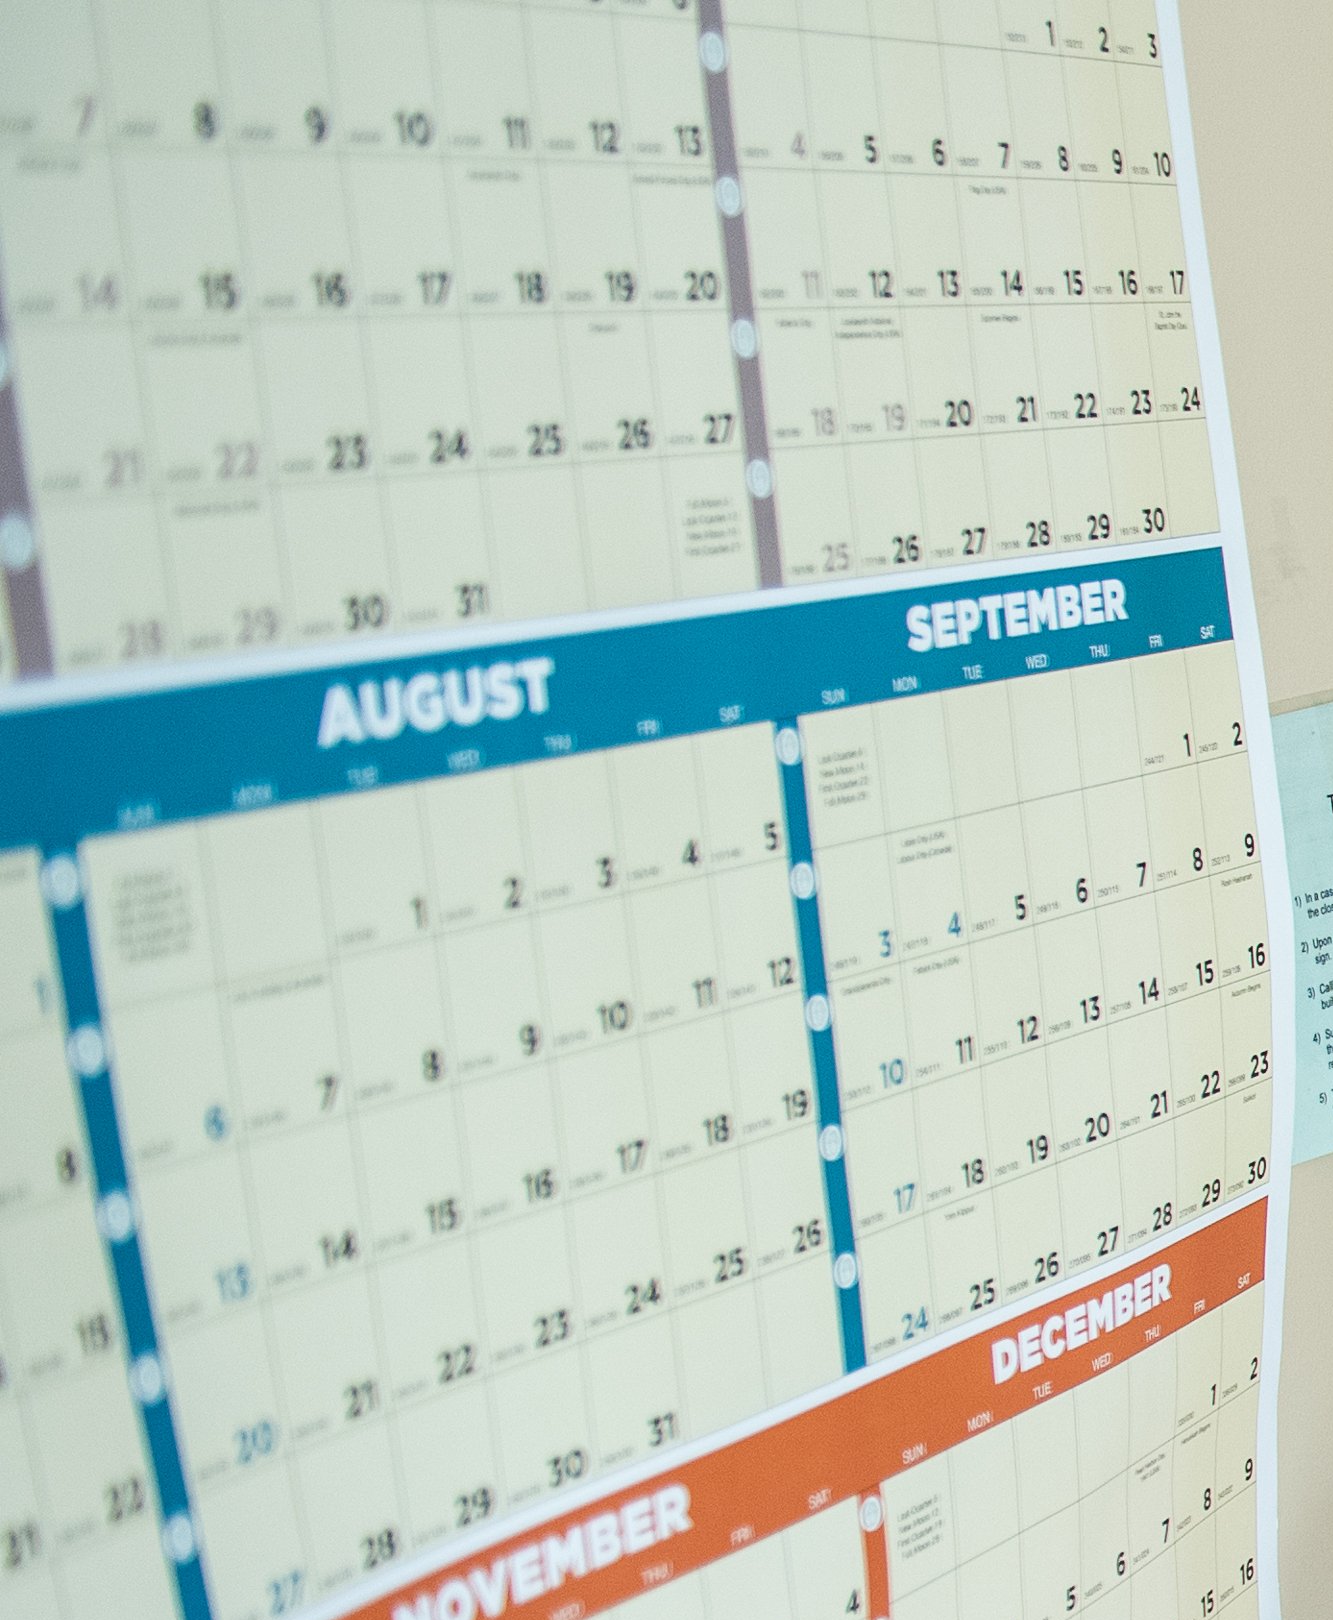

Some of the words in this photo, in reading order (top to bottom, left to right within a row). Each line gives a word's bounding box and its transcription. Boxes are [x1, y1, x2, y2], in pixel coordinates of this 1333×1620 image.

[503, 117, 530, 148] 11
[590, 122, 619, 154] 12
[869, 270, 893, 298] 12
[938, 270, 959, 297] 13
[1001, 270, 1023, 295] 14
[1064, 270, 1083, 295] 15
[1119, 270, 1138, 295] 16
[1170, 270, 1184, 294] 17
[907, 580, 1127, 652] SEPTEMBER
[893, 676, 917, 692] MON
[962, 665, 982, 681] TUE
[1025, 655, 1048, 669] WED
[1089, 645, 1108, 659] THU
[1149, 635, 1162, 648] FRI
[1200, 625, 1215, 640] SAT
[318, 656, 554, 749] AUGUST
[1015, 894, 1026, 920] 5
[1077, 878, 1088, 903] 6
[1136, 862, 1146, 887] 7
[1193, 847, 1203, 871] 8
[1245, 833, 1254, 857] 9
[1294, 895, 1302, 908] 1)
[1304, 893, 1313, 903] In
[1313, 892, 1319, 901] a
[1307, 908, 1319, 919] the
[1300, 941, 1309, 953] 2)
[1312, 936, 1332, 950] Upon
[1314, 952, 1330, 965] sign.
[1307, 986, 1315, 999] 3)
[1312, 1032, 1321, 1044] 4)
[1319, 1092, 1327, 1104] 5)
[525, 1169, 554, 1198] 16
[617, 1139, 646, 1172] 17
[704, 1114, 730, 1144] 18
[903, 1307, 929, 1340] 24
[971, 1278, 995, 1310] 25
[1035, 1252, 1059, 1283] 26
[1098, 1226, 1119, 1256] 27
[1153, 1202, 1172, 1231] 28
[1202, 1179, 1220, 1207] 29
[1248, 1157, 1266, 1184] 30
[992, 1263, 1171, 1385] DECEMBER
[1033, 1381, 1052, 1400] TUE
[1091, 1352, 1112, 1373] WED
[1145, 1325, 1160, 1344] THU
[1193, 1300, 1205, 1313] FRI
[1237, 1274, 1251, 1289] SAT
[1201, 1590, 1214, 1617] 15
[1240, 1558, 1254, 1585] 16
